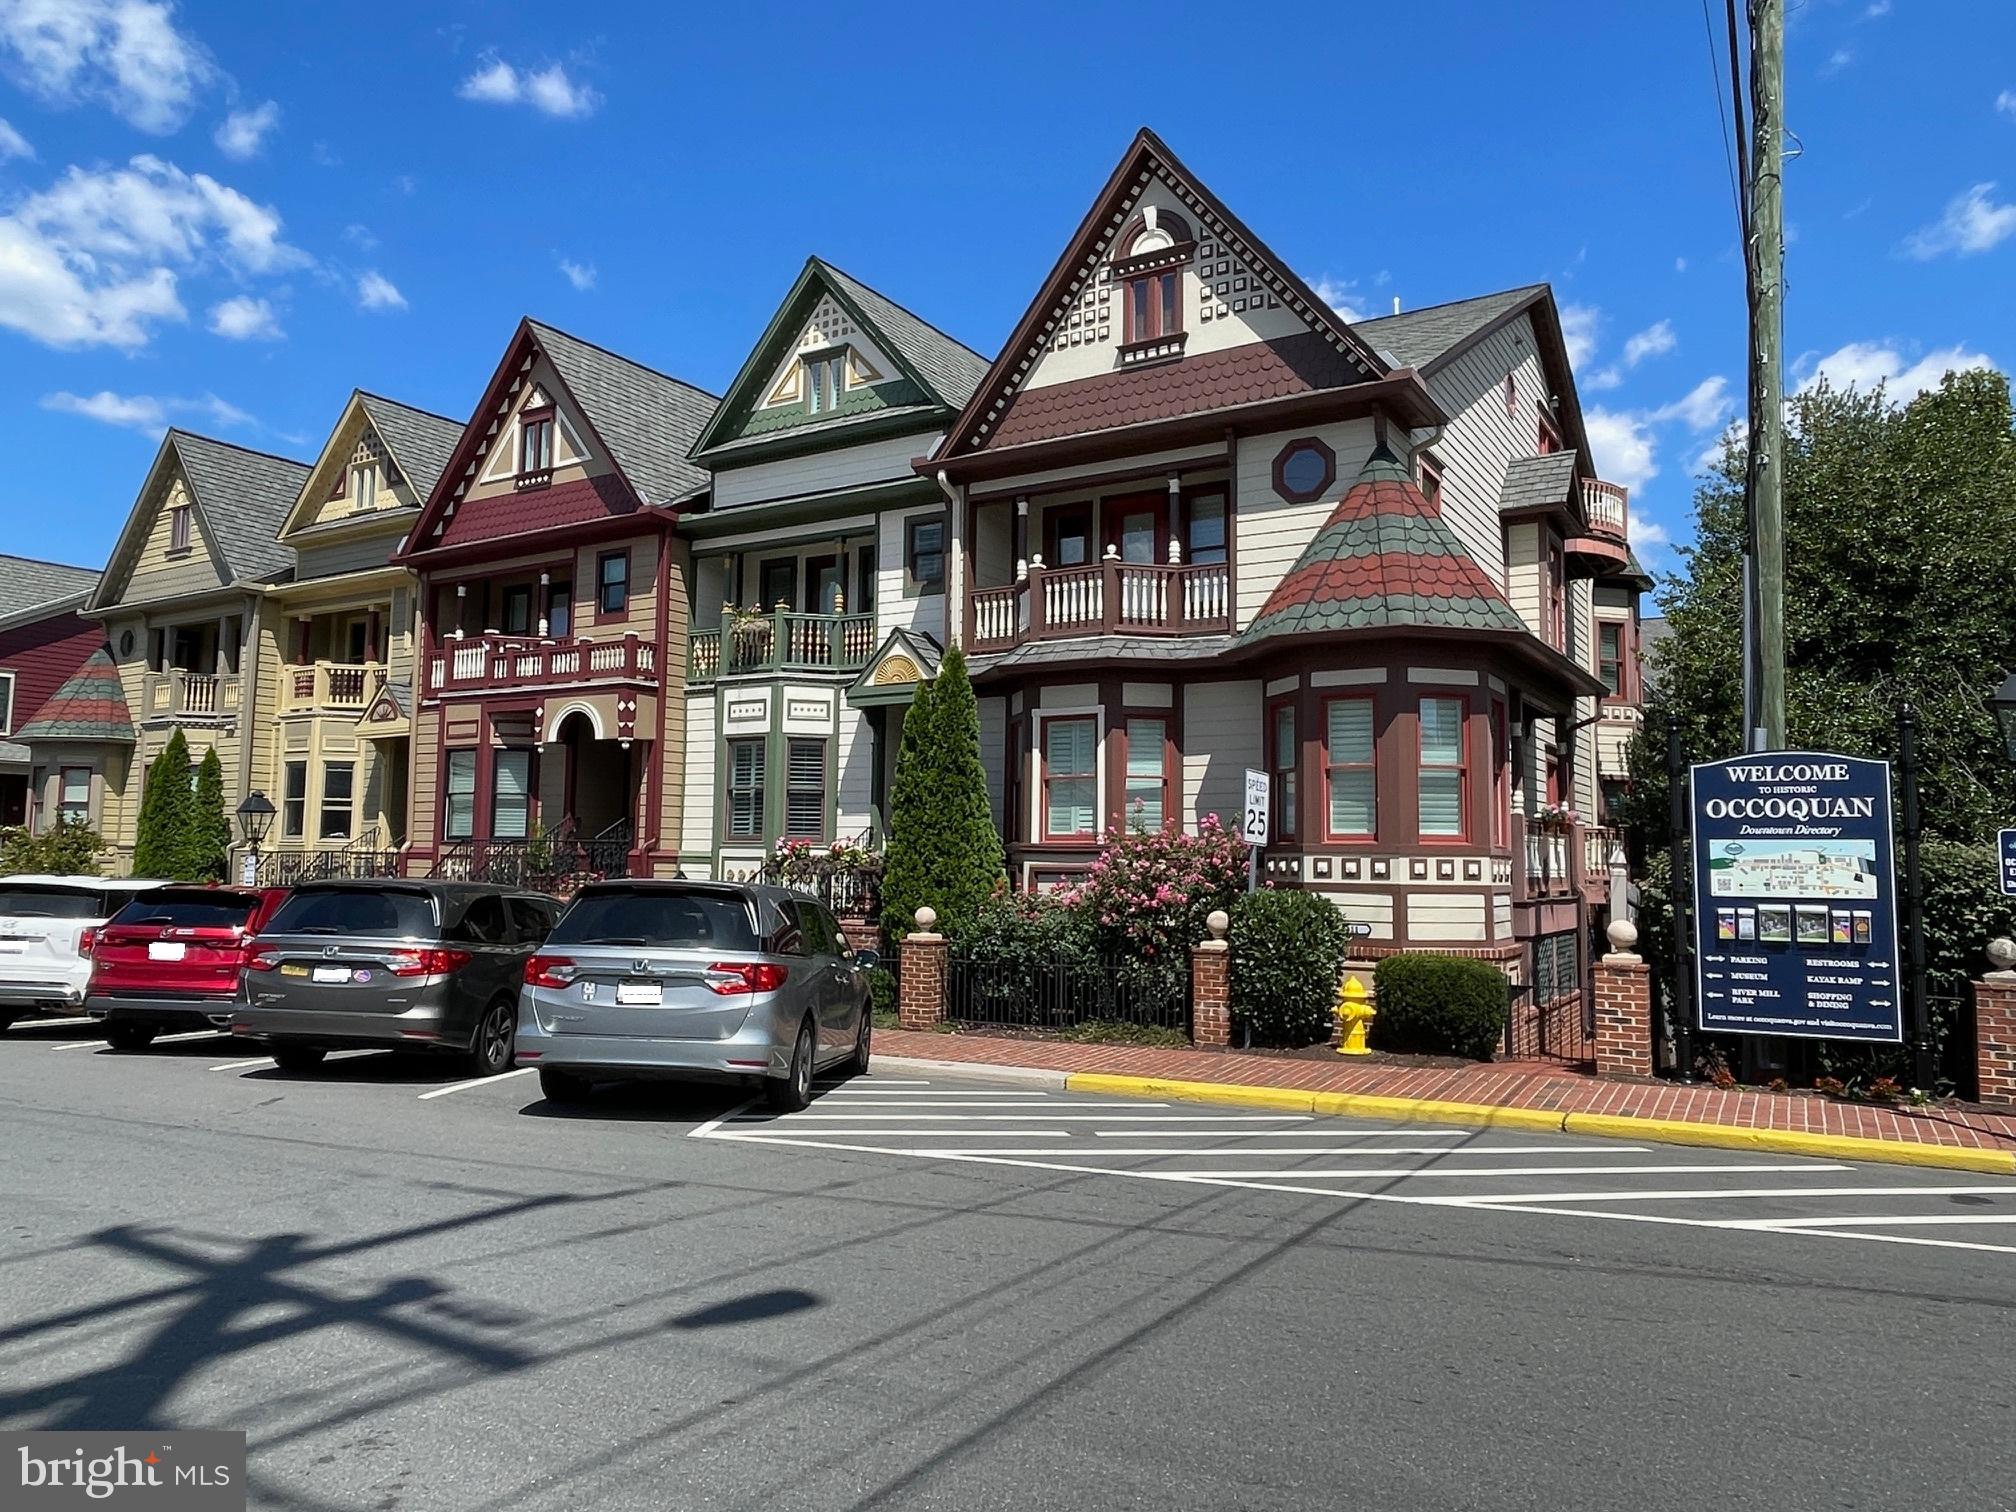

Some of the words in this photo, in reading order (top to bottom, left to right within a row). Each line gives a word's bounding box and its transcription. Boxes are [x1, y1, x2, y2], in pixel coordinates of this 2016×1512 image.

[1726, 764, 1850, 782] WELCOME
[1247, 777, 1267, 792] SPEED
[1758, 786, 1771, 794] TO
[1773, 785, 1817, 794] HISTORIC
[1249, 794, 1265, 806] LIMIT
[1706, 797, 1875, 821] OCCOQUAN
[1246, 809, 1266, 836] 25
[1740, 825, 1793, 835] Downtown
[1794, 825, 1842, 837] Directory
[1730, 956, 1768, 965] PARKING
[1806, 959, 1860, 968] RESTROOMS
[1731, 972, 1768, 981] MUSEUM
[1806, 976, 1836, 984] KAYAK
[1837, 977, 1863, 985] RAMP
[1731, 989, 1758, 997] RIVER
[1759, 990, 1780, 998] MILL
[1807, 992, 1853, 1001] SHOPPING
[1732, 997, 1754, 1005] PARK
[1808, 1000, 1815, 1008] &
[1816, 1001, 1849, 1010] DINING
[1707, 1013, 1726, 1021] Learn
